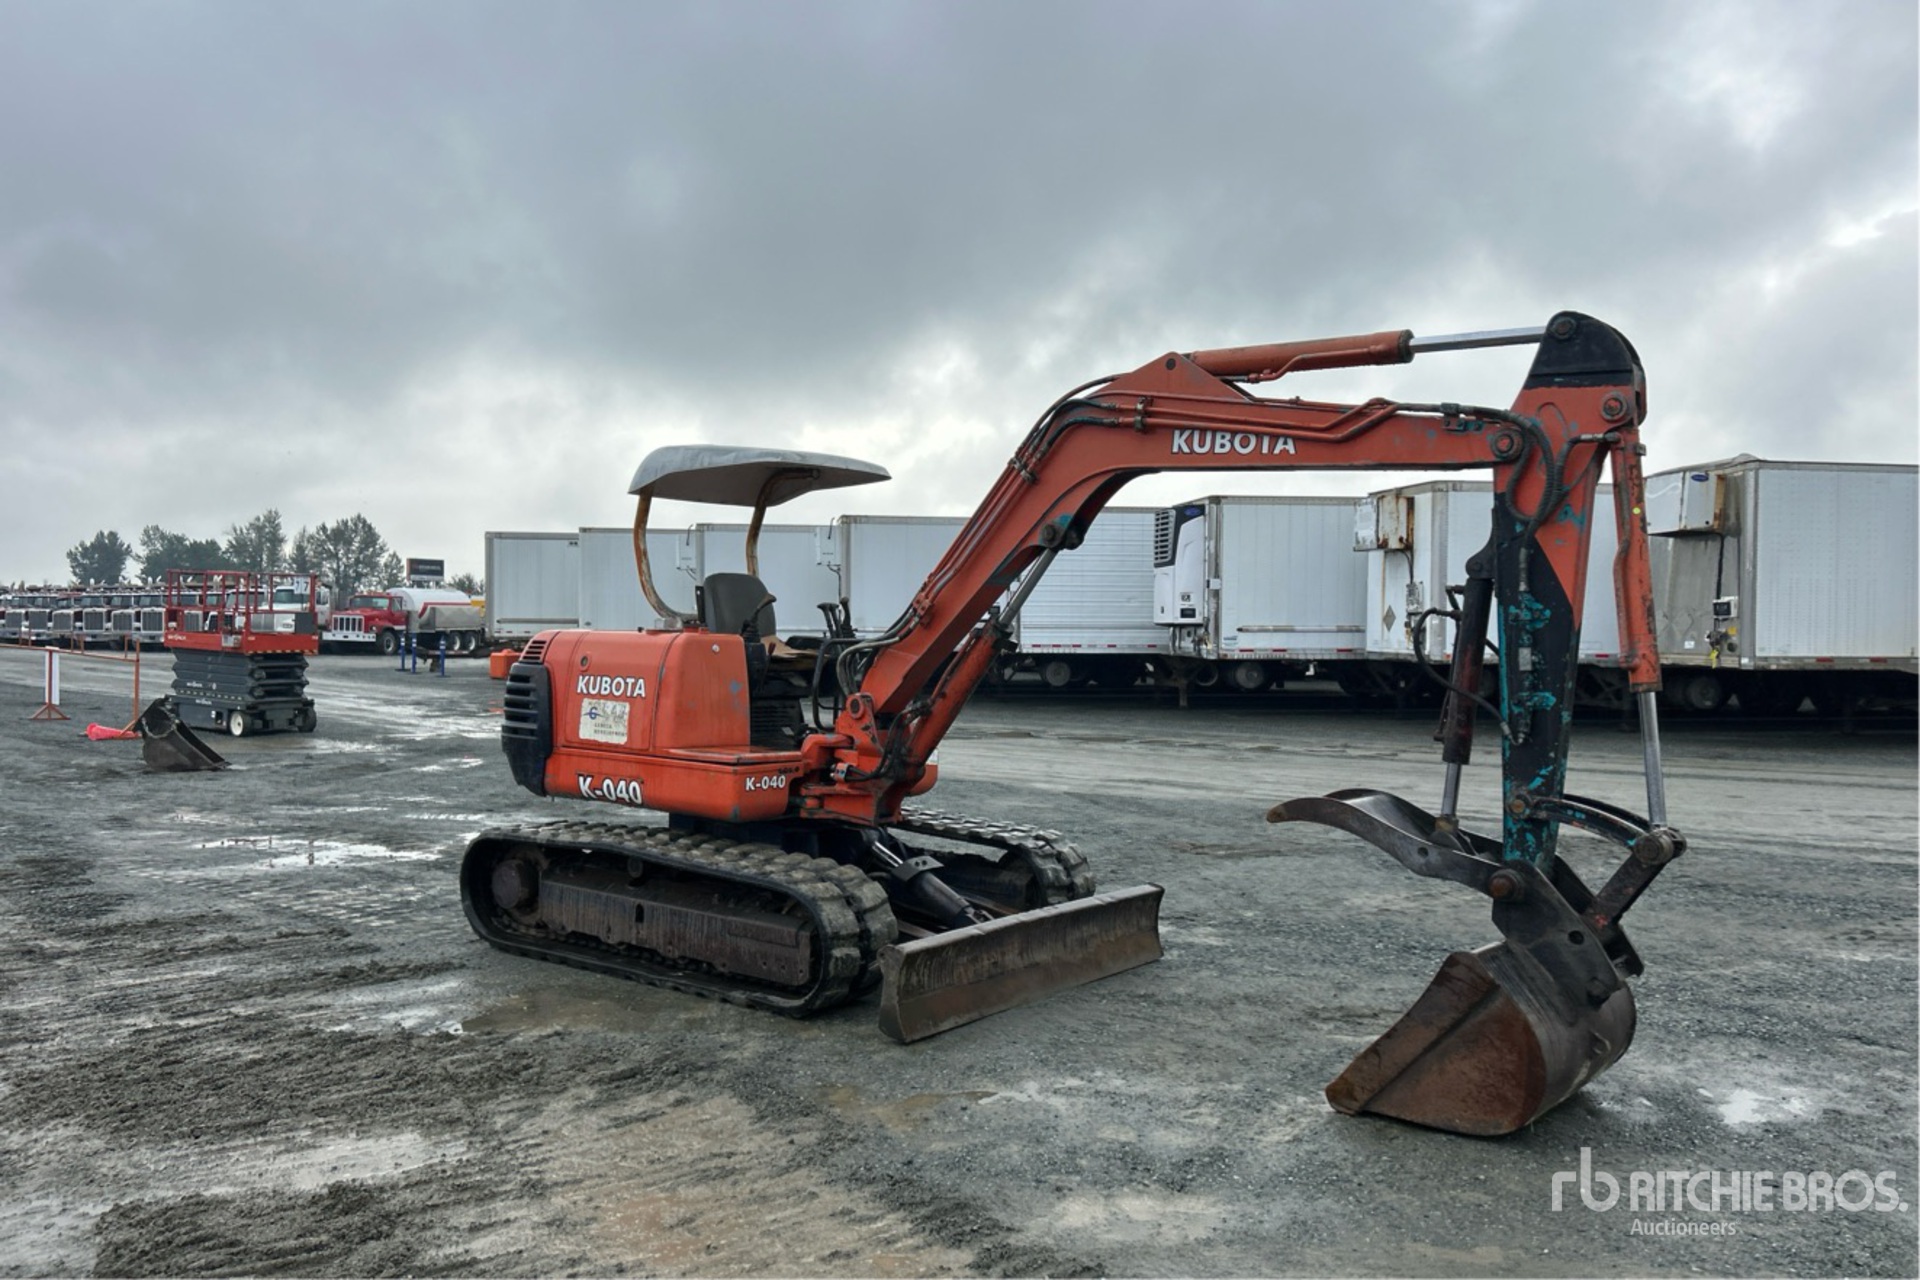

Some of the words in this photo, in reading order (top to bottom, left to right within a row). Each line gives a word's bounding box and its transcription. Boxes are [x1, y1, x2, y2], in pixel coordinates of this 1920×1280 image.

[1171, 429, 1297, 455] KUBOTA
[576, 674, 646, 698] KUBOTA
[577, 774, 643, 805] K-040
[745, 775, 786, 791] K-040
